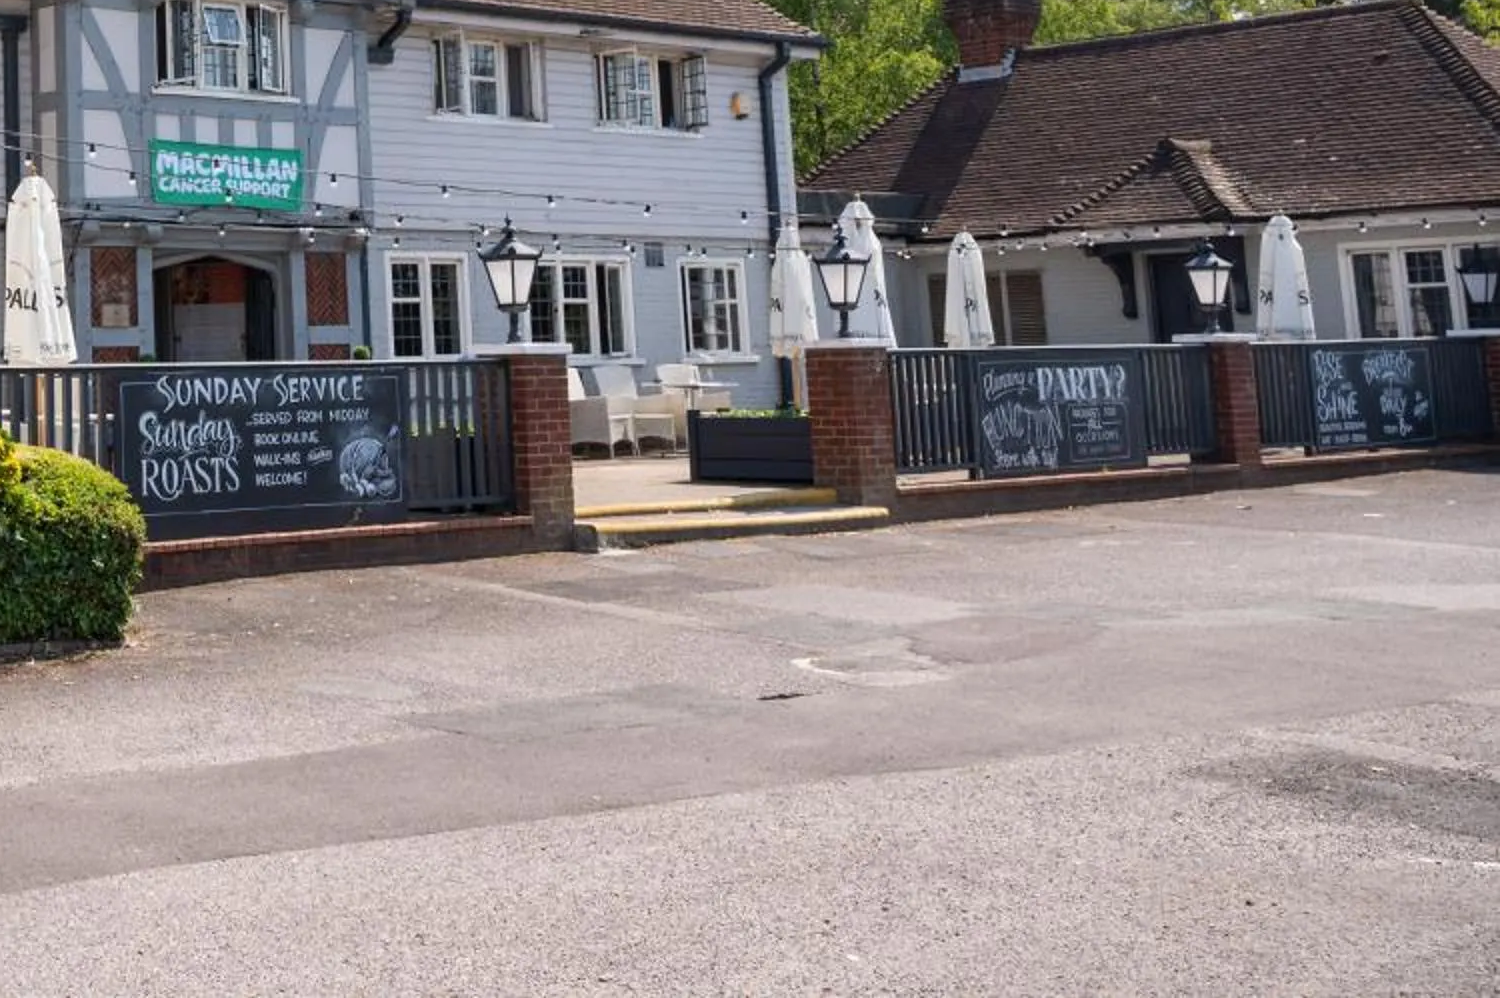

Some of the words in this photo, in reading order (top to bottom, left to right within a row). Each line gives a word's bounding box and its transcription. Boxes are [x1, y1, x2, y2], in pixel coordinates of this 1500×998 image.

[155, 149, 298, 181] MACMILLAN
[158, 176, 223, 195] CANCER
[225, 179, 291, 200] SUPPORT
[156, 374, 262, 414] SUNDAY
[273, 374, 366, 407] SERVICE
[1036, 363, 1127, 402] PARTY?
[138, 409, 243, 454] Sunday
[251, 411, 293, 427] SERVED
[296, 408, 323, 423] FROM
[328, 406, 370, 422] MIDDAY
[140, 455, 242, 502] ROASTS
[255, 471, 308, 487] WELCOME!
